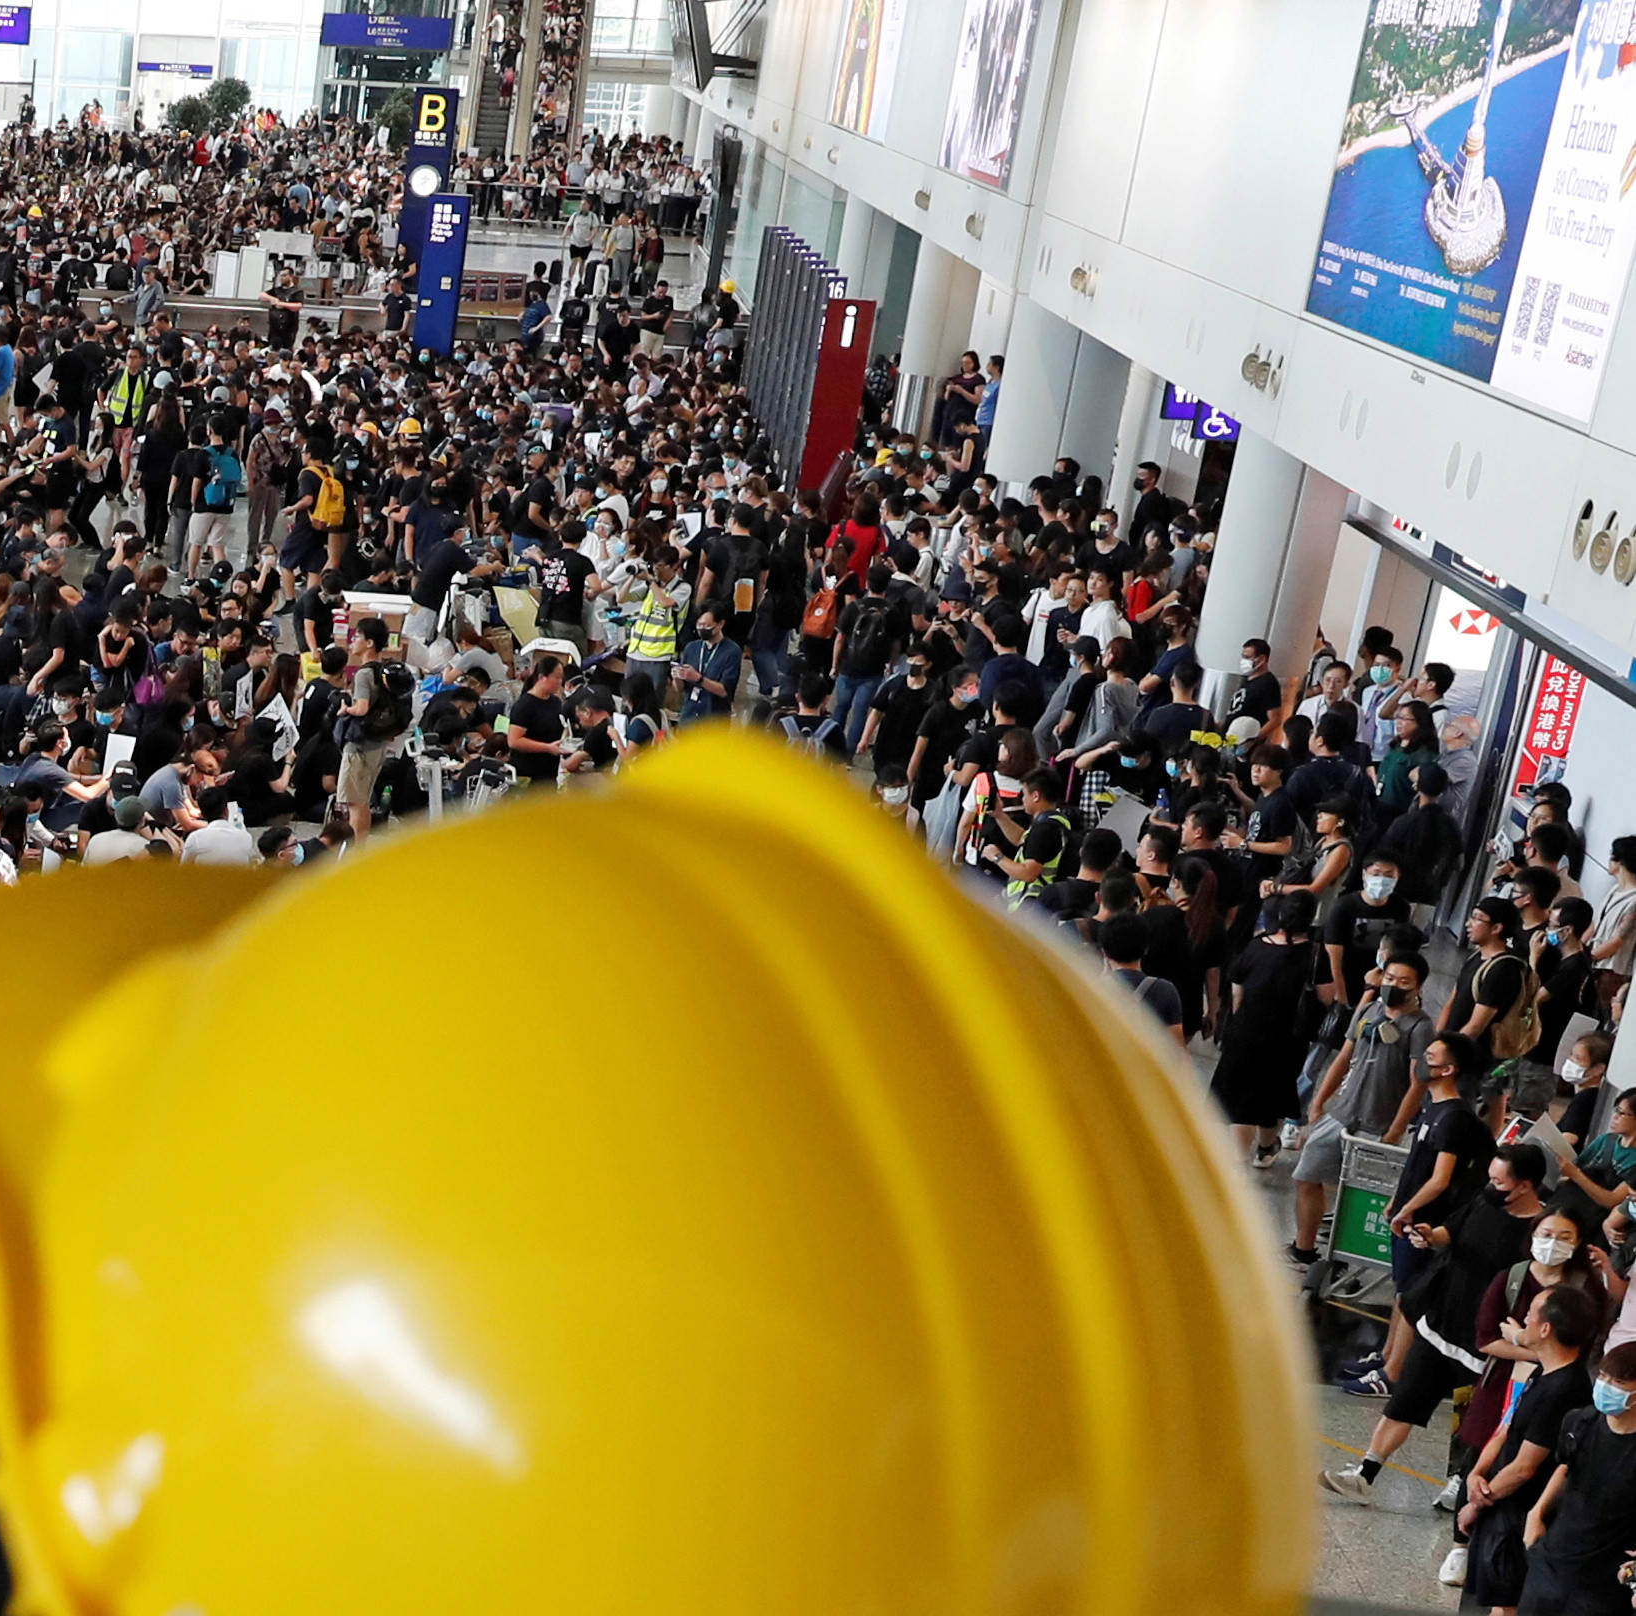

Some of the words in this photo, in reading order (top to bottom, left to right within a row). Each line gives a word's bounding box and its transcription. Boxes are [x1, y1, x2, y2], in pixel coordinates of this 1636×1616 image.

[419, 94, 447, 131] B
[1564, 104, 1618, 155] Hainan
[1567, 166, 1610, 204] Countries
[1545, 206, 1564, 237] Visa
[1565, 209, 1585, 242] Free
[1585, 213, 1615, 258] Entry
[828, 281, 845, 299] 16
[1559, 701, 1575, 728] your
[1552, 729, 1568, 751] Get
